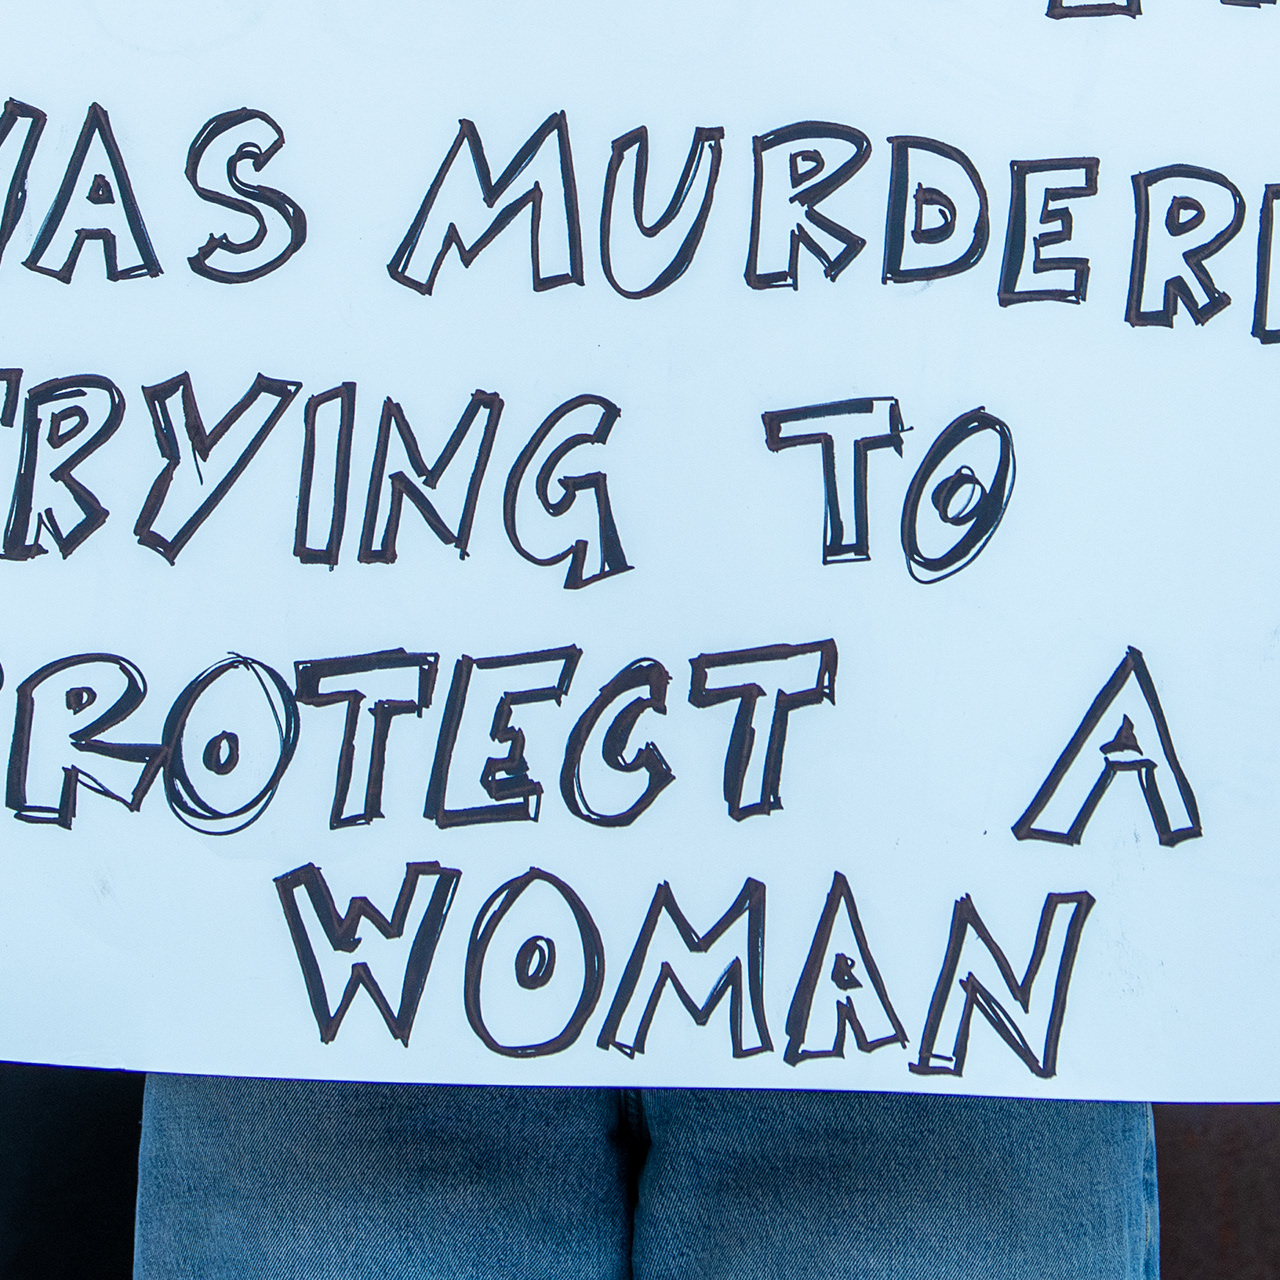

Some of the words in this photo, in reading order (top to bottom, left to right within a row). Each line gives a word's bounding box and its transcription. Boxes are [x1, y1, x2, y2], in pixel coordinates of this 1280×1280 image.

[761, 396, 1017, 585] TO
[1011, 646, 1203, 847] A
[274, 860, 1096, 1078] WOMAN
